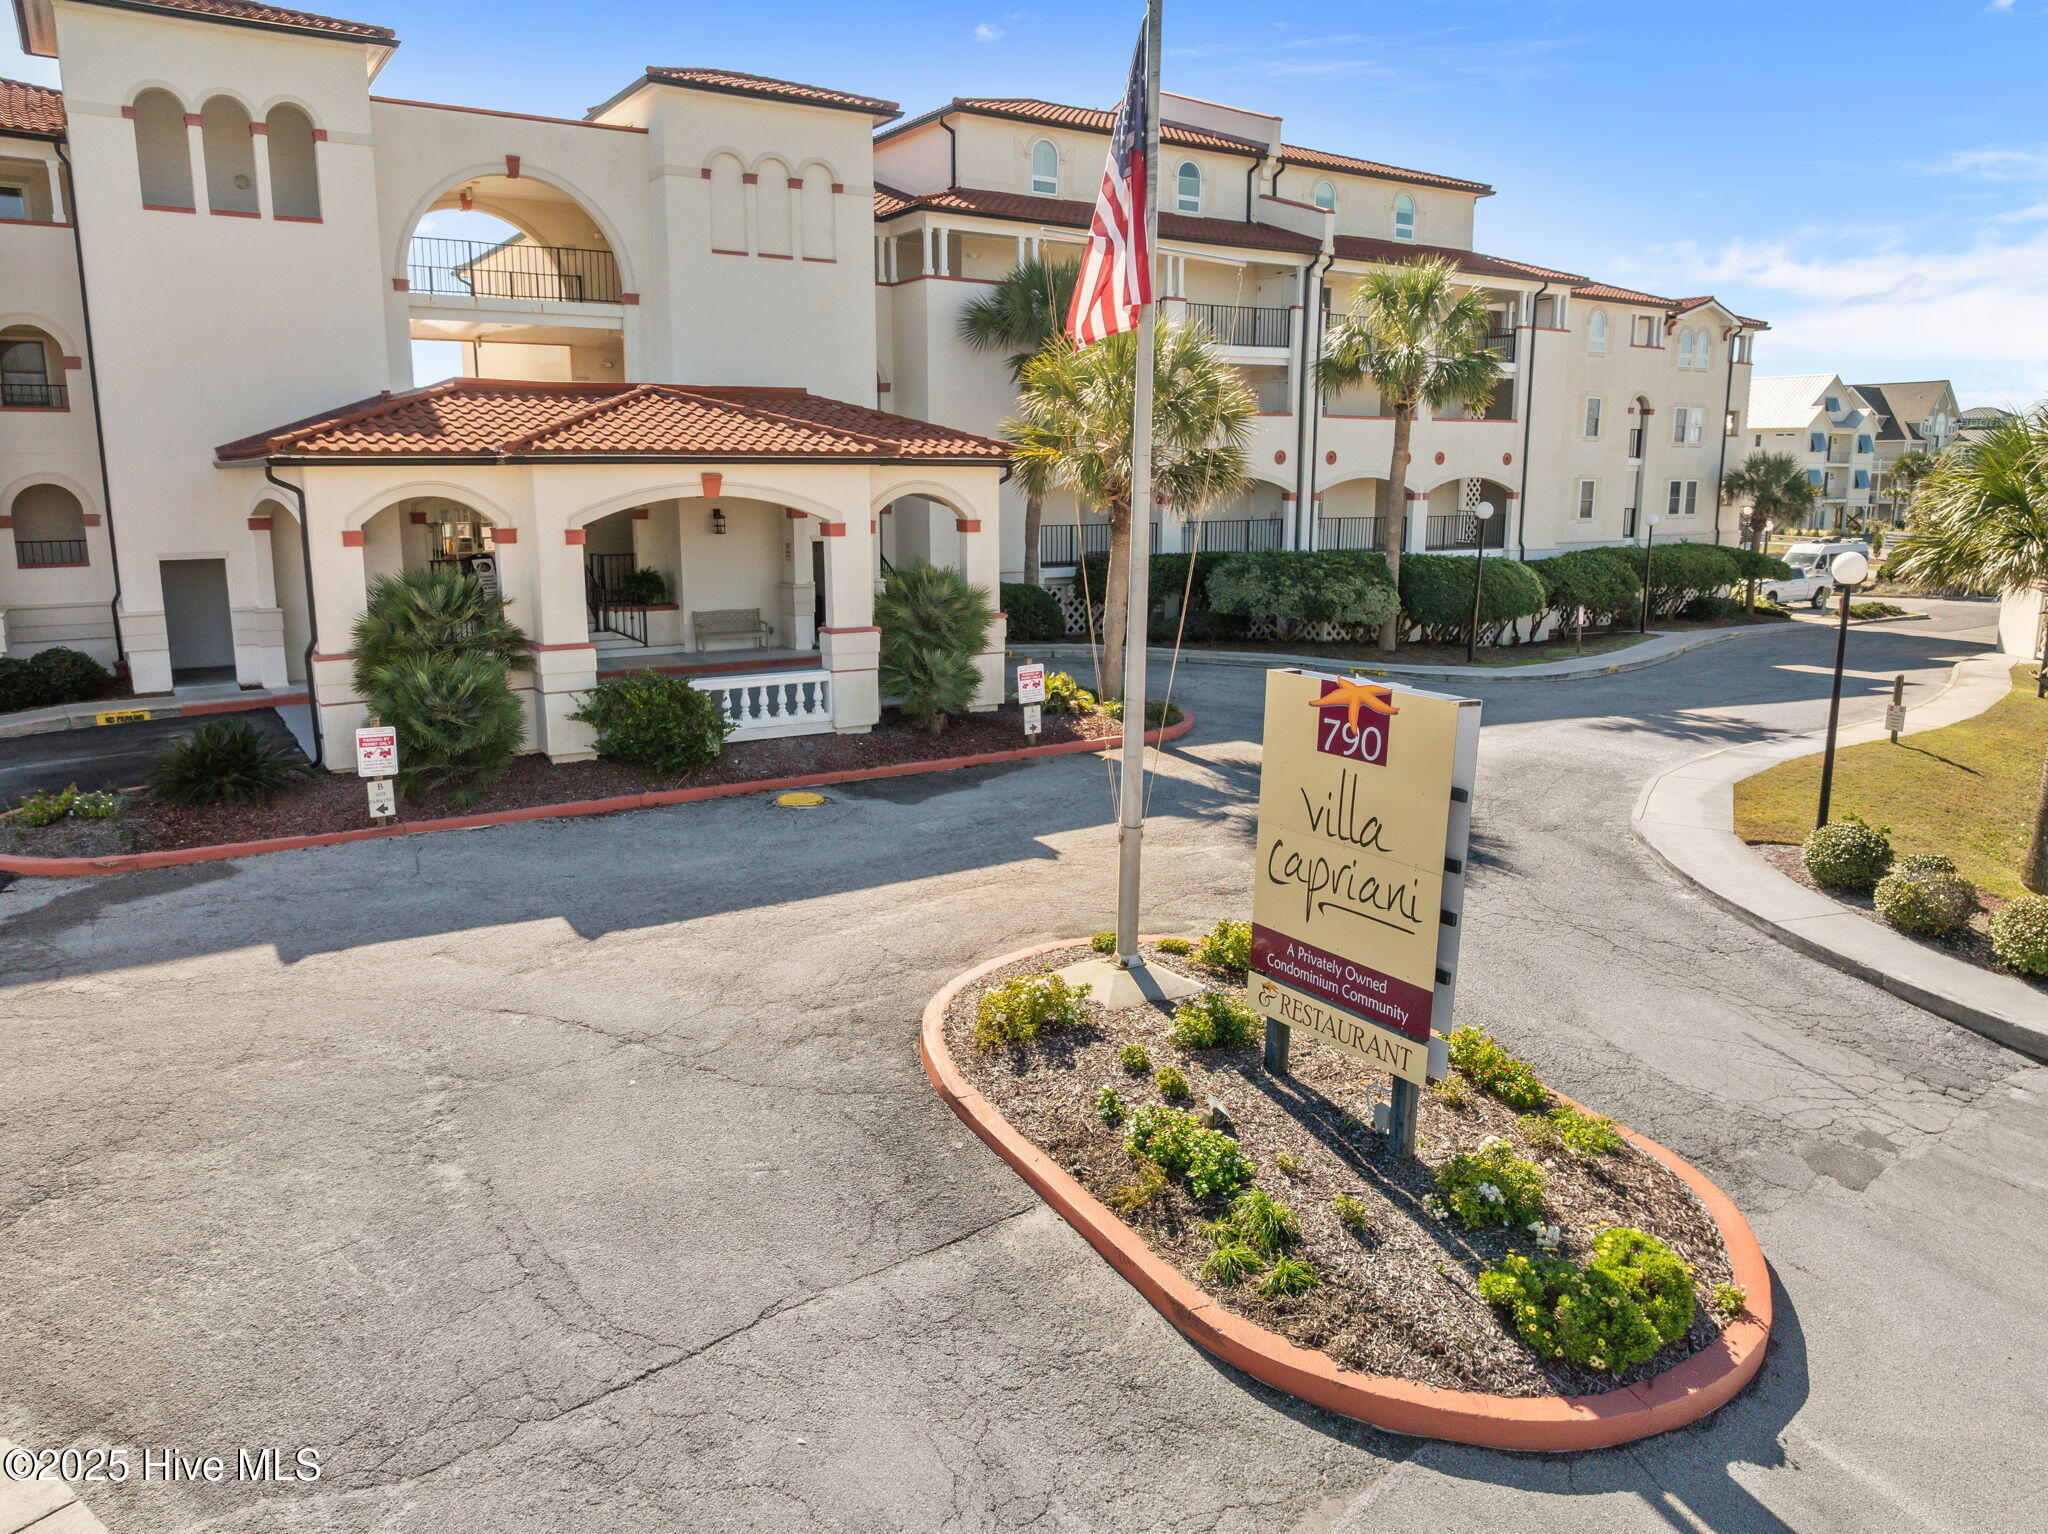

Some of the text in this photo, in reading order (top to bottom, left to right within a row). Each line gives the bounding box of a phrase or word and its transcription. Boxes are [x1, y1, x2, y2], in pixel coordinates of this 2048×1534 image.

[117, 713, 145, 722] PARKING
[1323, 717, 1382, 761] 790
[377, 782, 384, 790] B
[1268, 839, 1424, 923] Capriani
[1267, 953, 1409, 1025] Condominium Community
[1286, 943, 1388, 994] A Privately Owned
[1258, 983, 1413, 1072] & RESTAURANT
